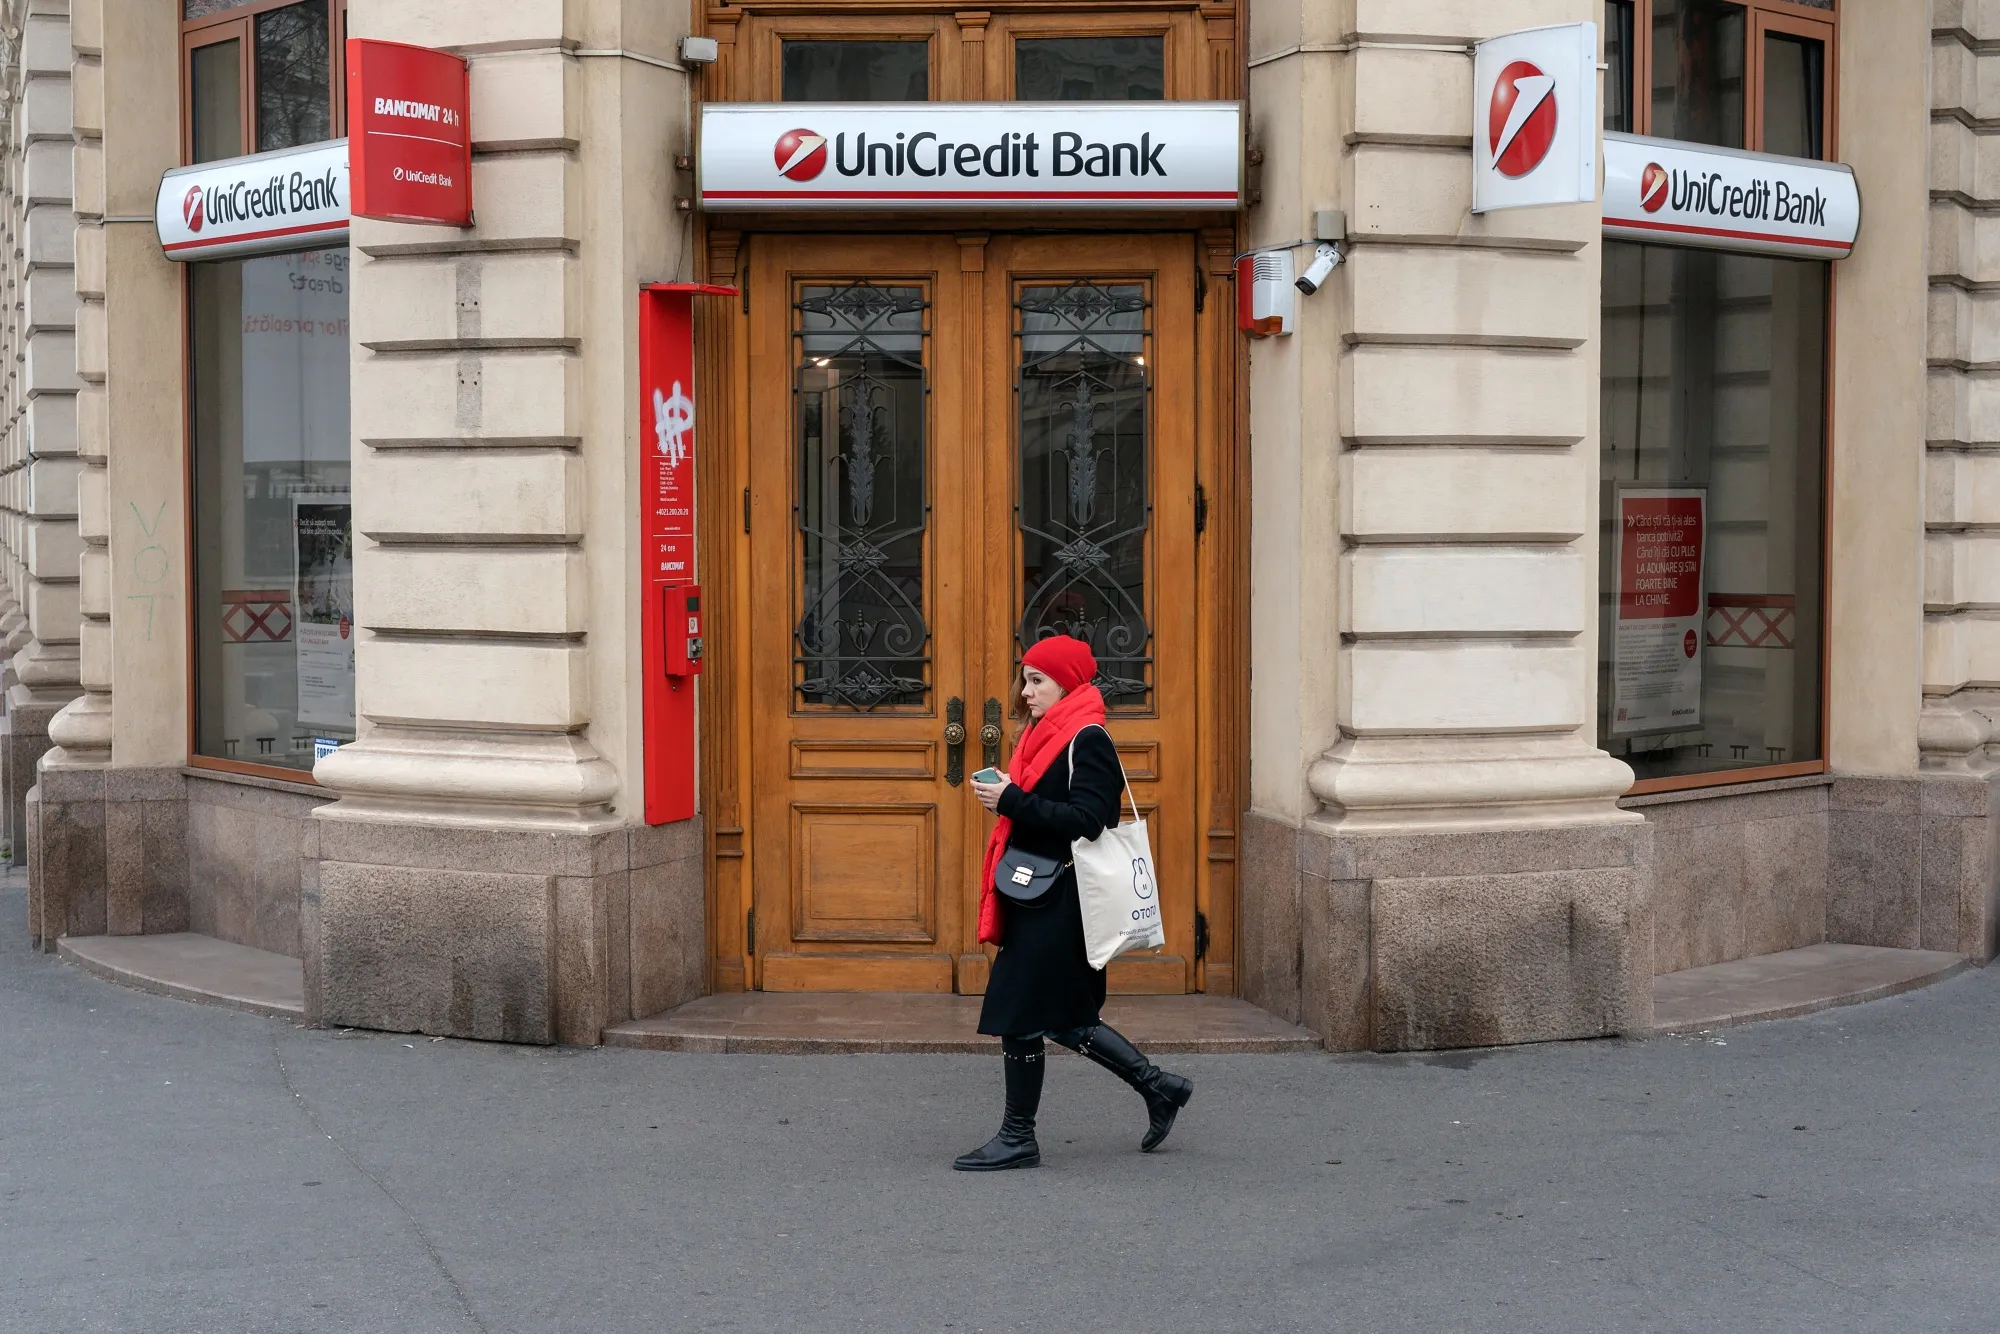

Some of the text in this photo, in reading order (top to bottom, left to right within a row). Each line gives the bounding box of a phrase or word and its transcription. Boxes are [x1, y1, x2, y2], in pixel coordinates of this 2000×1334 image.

[374, 97, 459, 127] BANCOMAT 24 h
[835, 131, 1168, 178] UniCredit Bank
[405, 170, 453, 187] UniCredit Bank
[206, 166, 340, 225] UniCredit Bank
[1671, 168, 1827, 227] UniCredit Bank
[1683, 514, 1697, 526] ales
[1636, 531, 1656, 543] banca
[660, 544, 667, 552] 24
[1670, 546, 1680, 557] CU
[1681, 545, 1696, 557] PLUS
[660, 561, 685, 571] BANCOMAT
[1636, 563, 1646, 574] LA
[1646, 562, 1678, 574] ADUNARE
[1684, 561, 1697, 573] STAI
[1635, 577, 1678, 590] FOARTE BINE
[1635, 594, 1645, 606] LA
[1131, 904, 1157, 920] OTOTO
